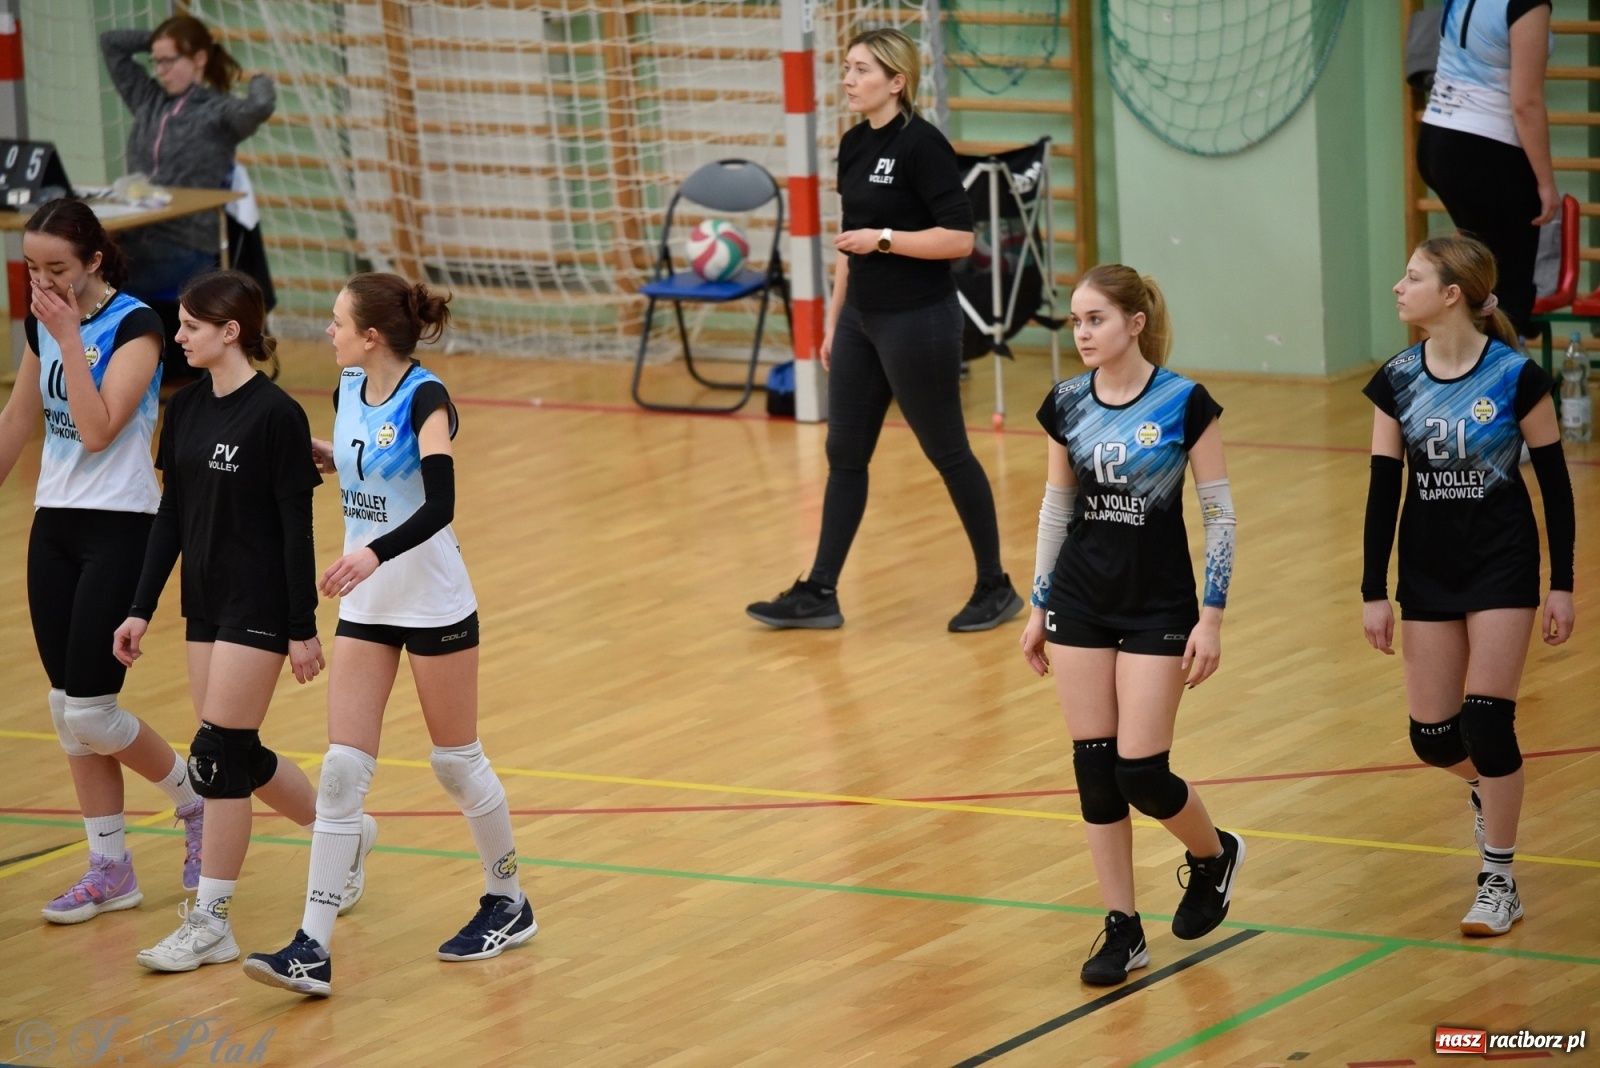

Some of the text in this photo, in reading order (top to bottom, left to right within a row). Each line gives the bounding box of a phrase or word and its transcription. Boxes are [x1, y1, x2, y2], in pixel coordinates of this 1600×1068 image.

[874, 157, 896, 175] PV
[869, 174, 895, 184] VOLLEY
[1425, 417, 1467, 460] 21
[212, 443, 239, 462] PV
[351, 438, 365, 481] 7
[208, 460, 240, 473] VOLLEY
[1093, 442, 1128, 484] 12
[1433, 470, 1486, 487] VOLLEY
[350, 490, 387, 511] VOLLEY
[1085, 494, 1147, 513] V VOLLEY
[343, 505, 389, 523] RAPKOWICE
[1084, 510, 1146, 526] KRAPKOWICE
[441, 631, 468, 642] COLO
[1420, 724, 1452, 735] ALLSIX
